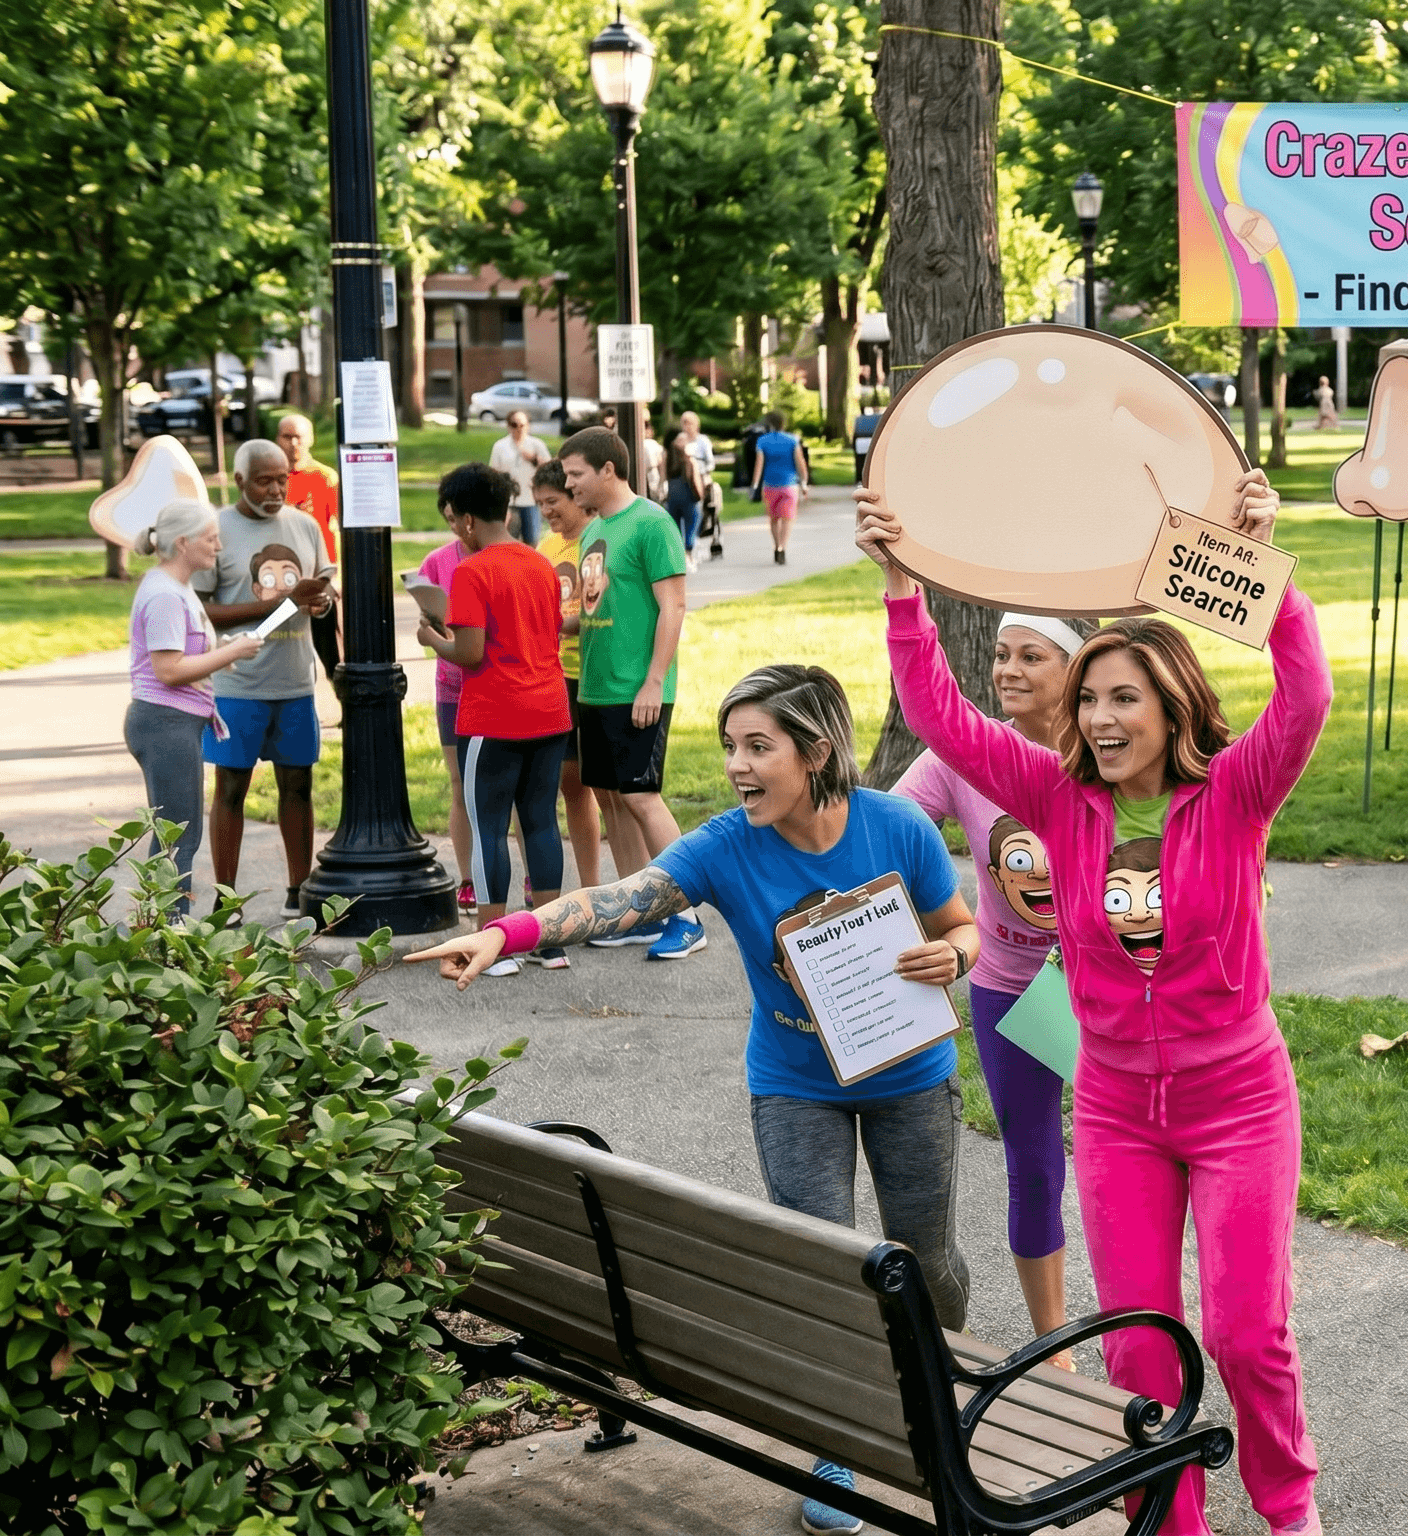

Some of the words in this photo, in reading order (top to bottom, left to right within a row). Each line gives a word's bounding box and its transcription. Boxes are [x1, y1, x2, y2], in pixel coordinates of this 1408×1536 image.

[1197, 531, 1231, 555] Item
[1168, 544, 1266, 600] Silicone
[1164, 574, 1248, 626] Search
[796, 925, 842, 953] Beauty
